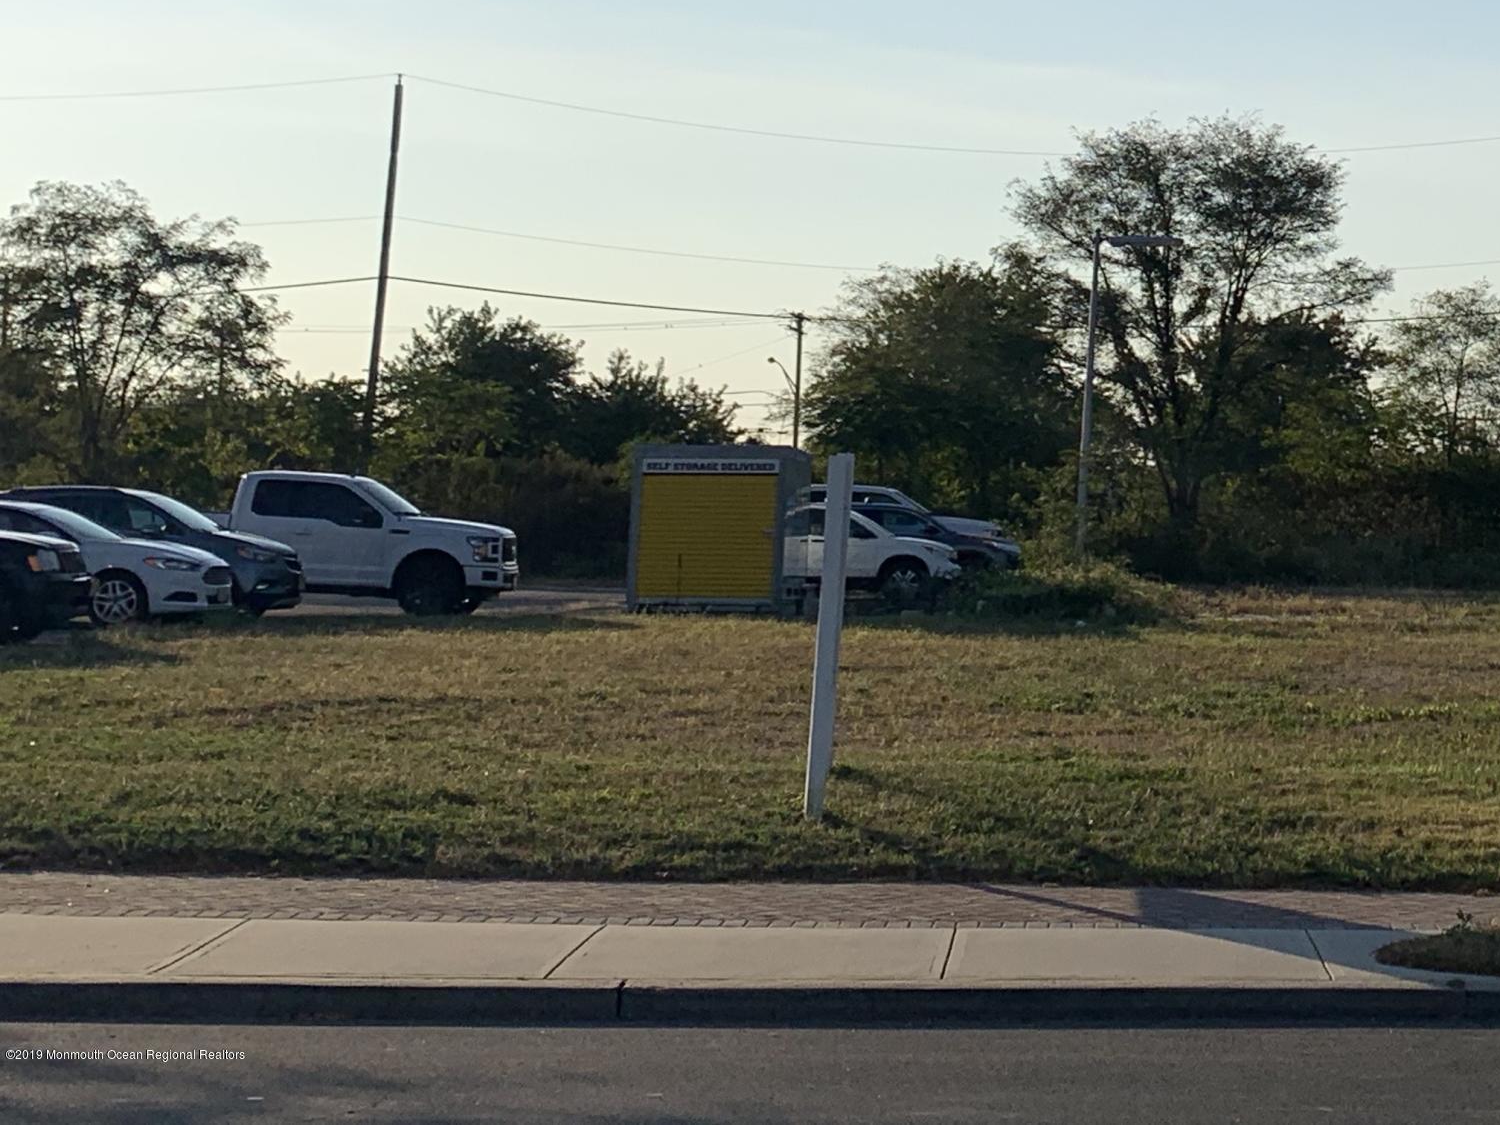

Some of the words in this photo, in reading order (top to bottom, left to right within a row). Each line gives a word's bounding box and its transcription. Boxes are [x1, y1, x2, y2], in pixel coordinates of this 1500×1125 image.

[646, 462, 671, 471] SELF
[673, 462, 719, 471] STORAGE
[721, 462, 775, 471] DELIVERED
